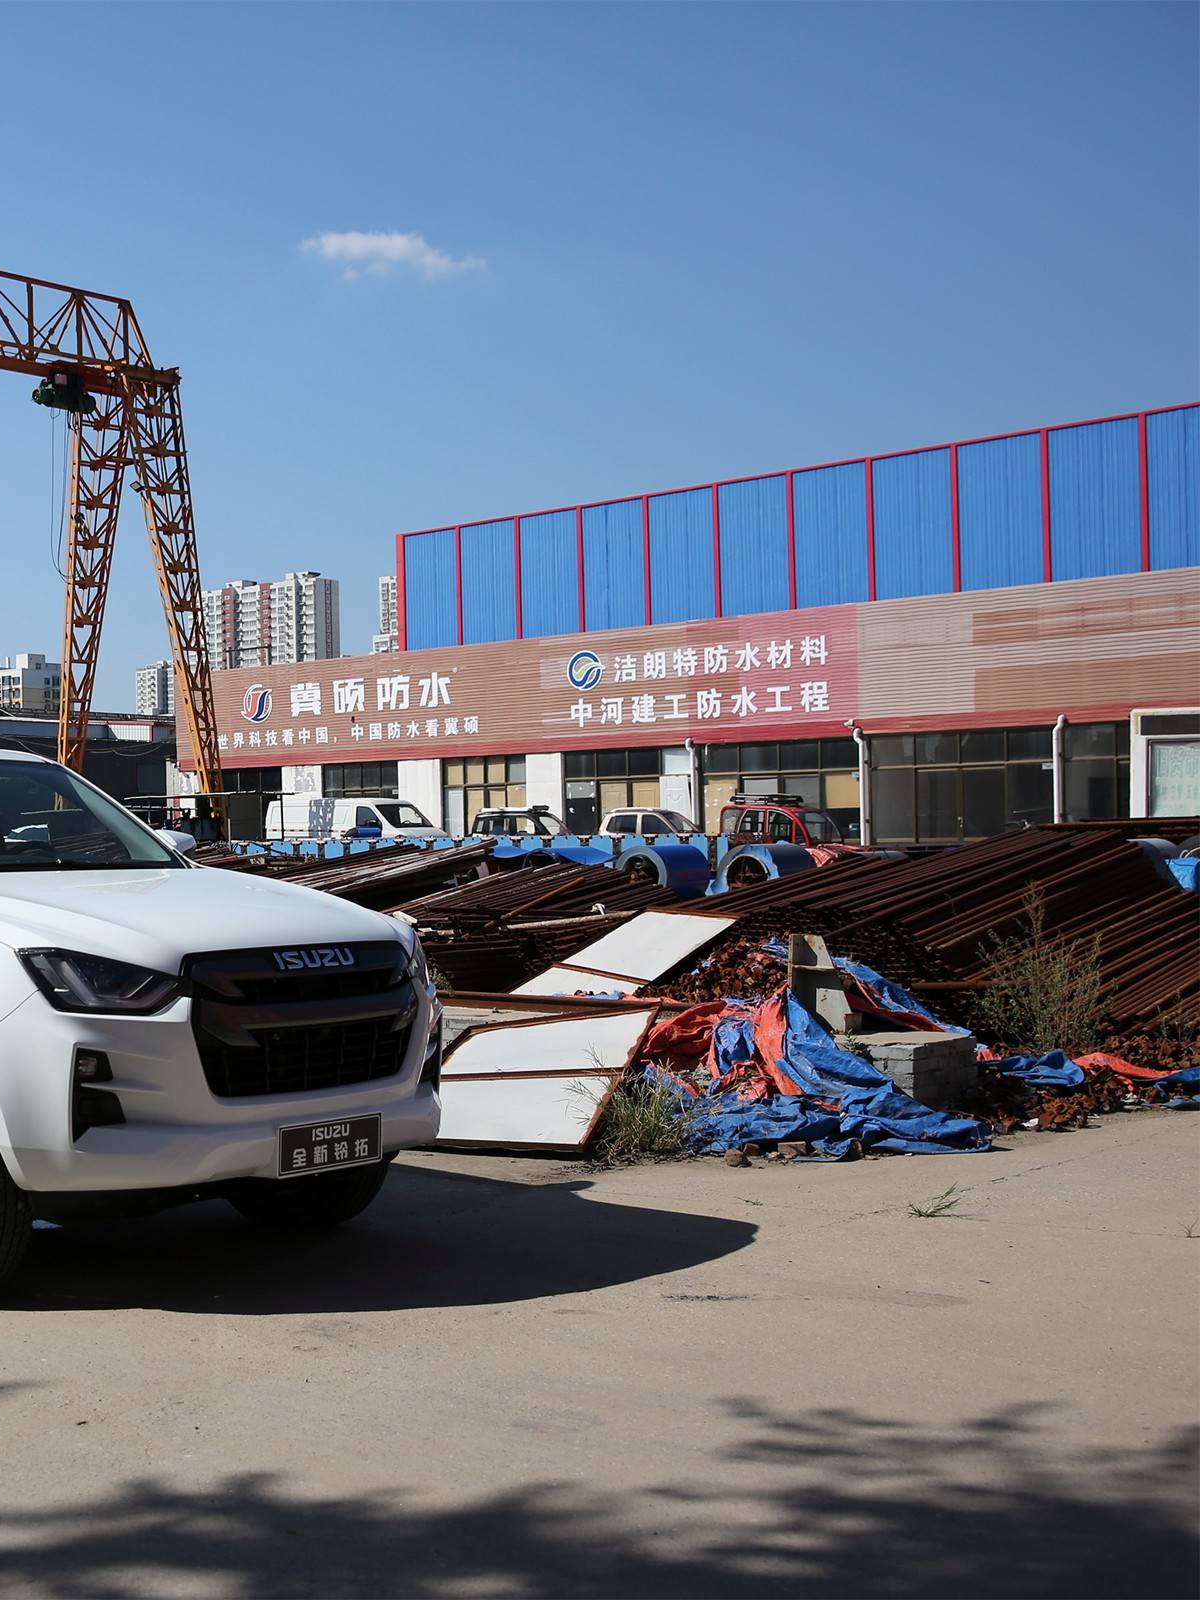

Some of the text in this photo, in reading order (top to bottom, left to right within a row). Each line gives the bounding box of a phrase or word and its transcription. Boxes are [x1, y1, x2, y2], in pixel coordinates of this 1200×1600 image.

[614, 634, 829, 683] 洁朗特防水材料
[290, 671, 451, 718] 冀硕防水
[569, 680, 830, 728] 中河建工防水工程
[272, 947, 355, 971] ISUZU
[312, 1123, 350, 1141] ISUZU
[292, 1138, 368, 1168] 全新铃拓
